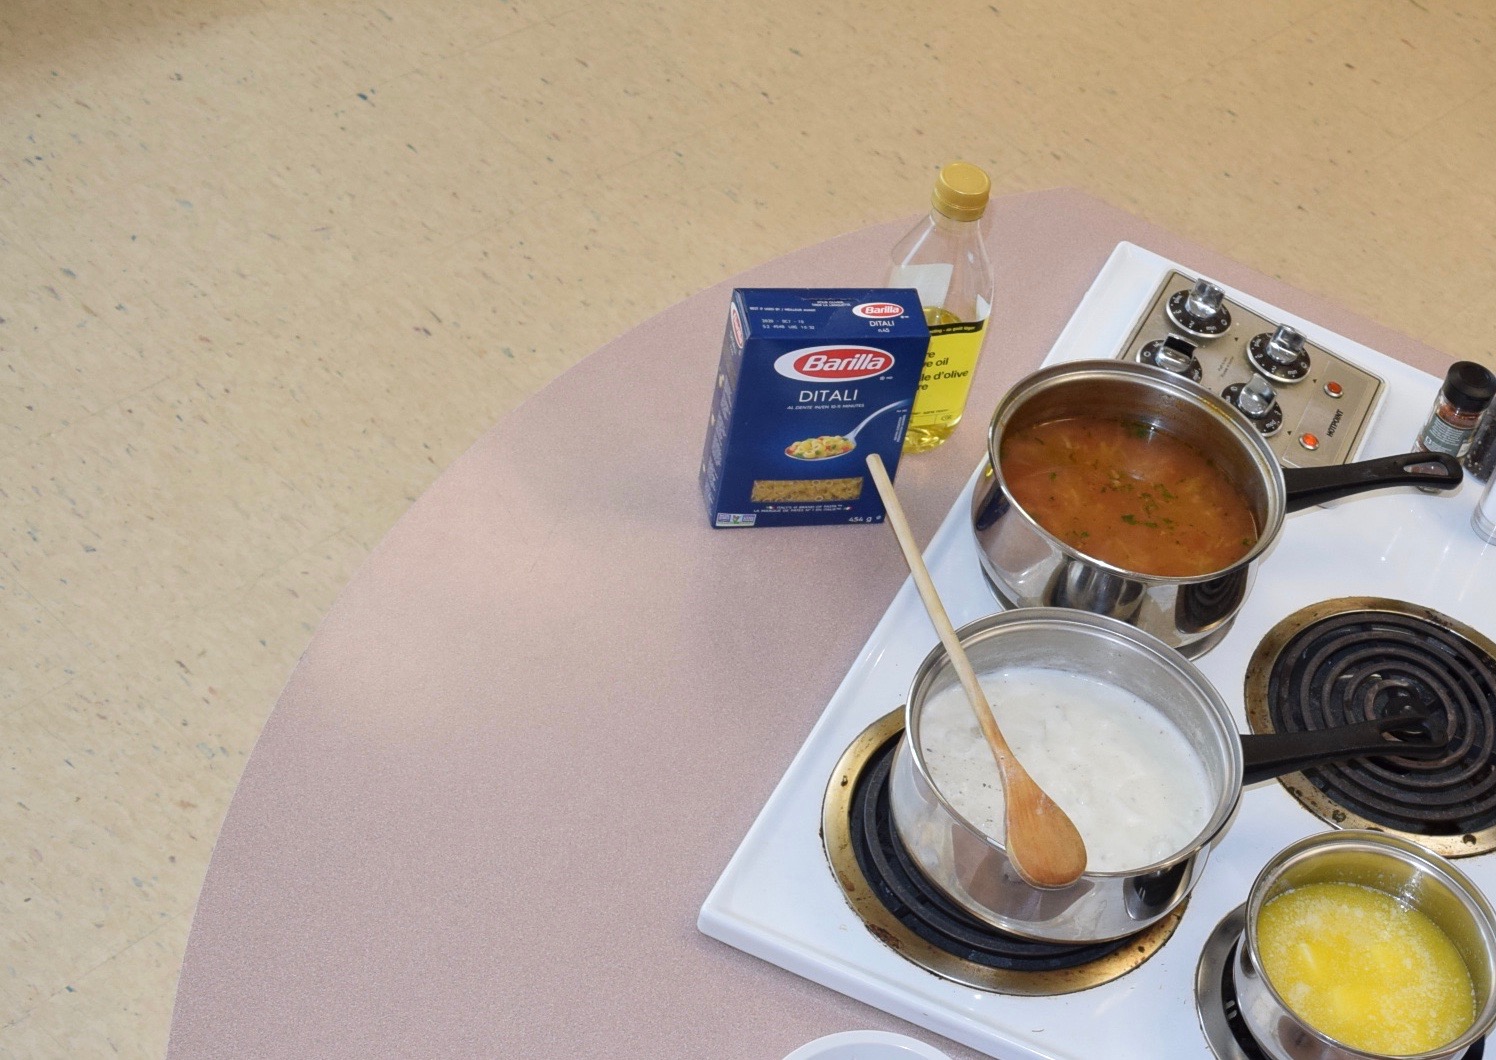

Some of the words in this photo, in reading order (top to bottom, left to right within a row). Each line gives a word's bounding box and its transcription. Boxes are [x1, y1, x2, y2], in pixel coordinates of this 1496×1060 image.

[865, 306, 900, 315] Barilla
[802, 354, 886, 372] Barilla
[936, 358, 949, 367] oil
[934, 370, 968, 380] d'olive
[799, 389, 858, 402] DITALI
[1326, 409, 1344, 437] HOTPOINT
